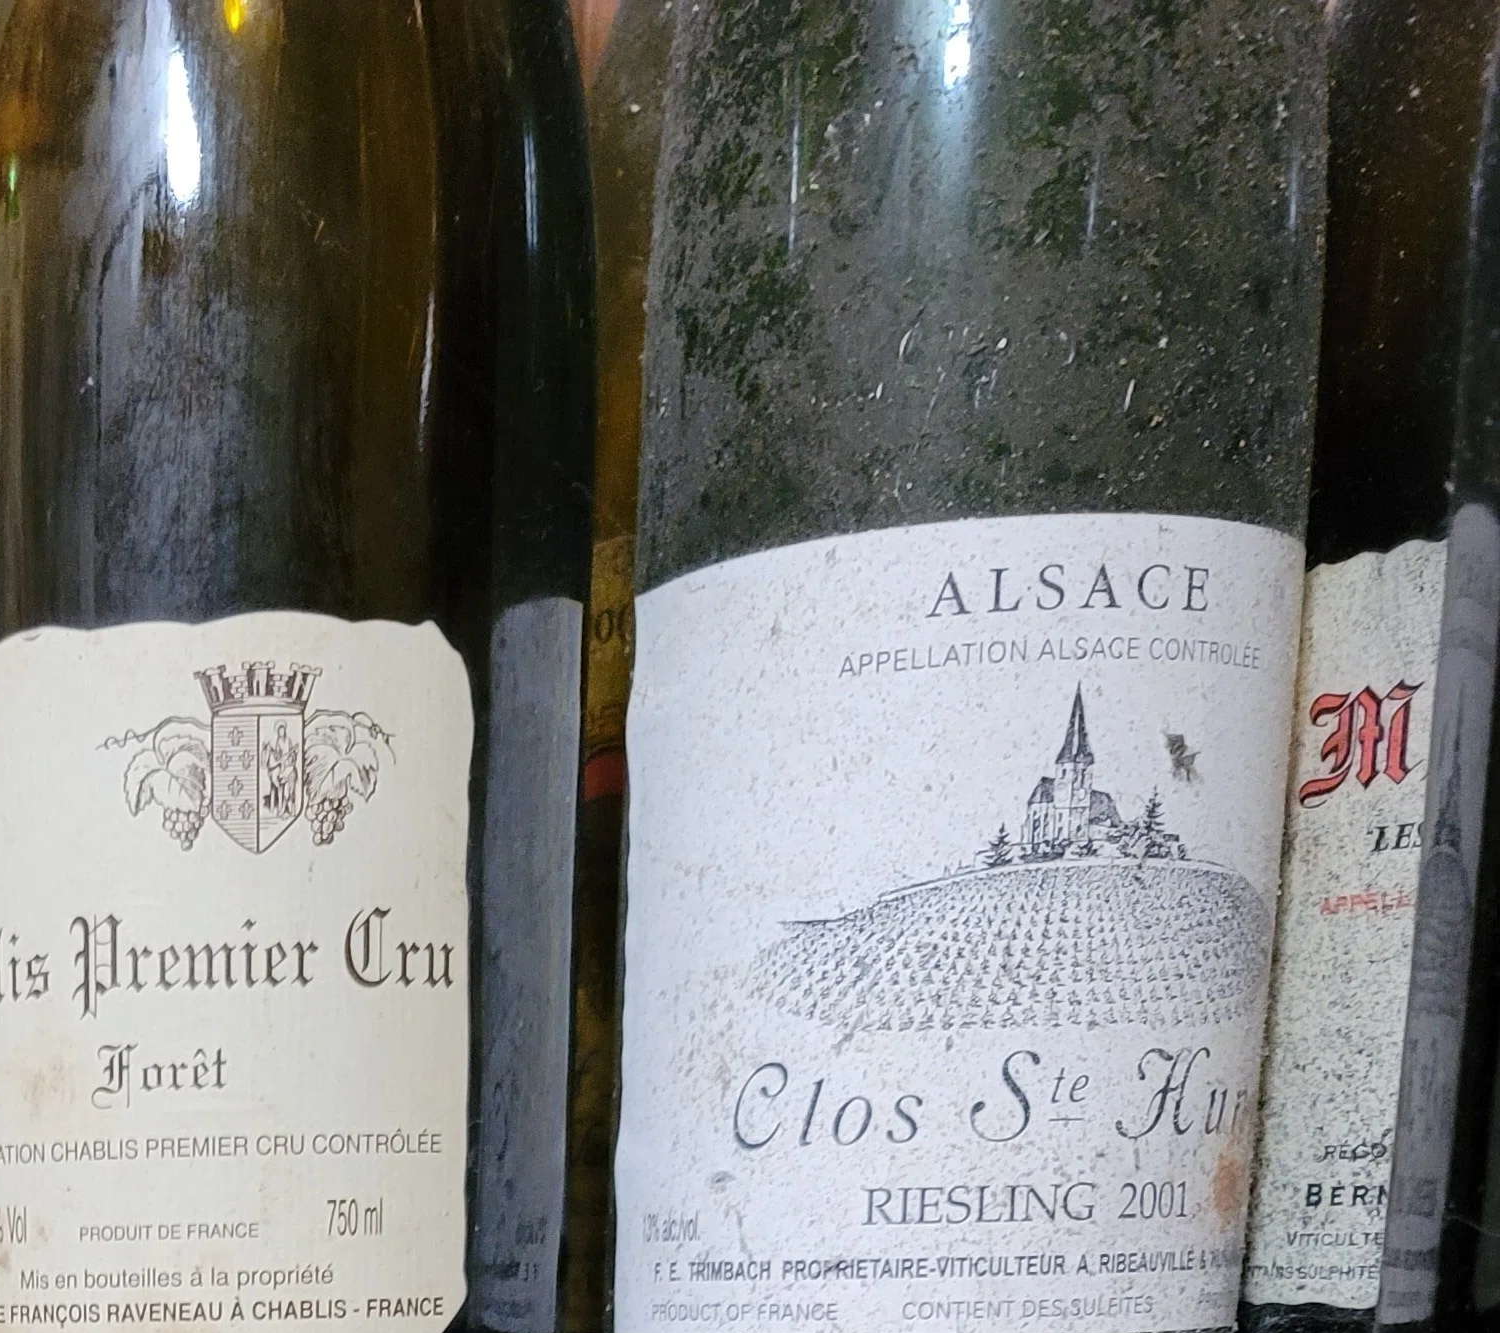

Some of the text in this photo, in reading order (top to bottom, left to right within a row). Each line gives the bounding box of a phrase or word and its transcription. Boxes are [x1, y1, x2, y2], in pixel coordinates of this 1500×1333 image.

[924, 562, 1211, 618] ALSACE
[837, 638, 1028, 679] APPELLATION
[1036, 636, 1141, 661] ALSACE
[1319, 887, 1415, 917] APPELL
[69, 911, 320, 1021] Premier
[344, 906, 457, 990] Cru
[91, 1042, 228, 1109] Forêt
[732, 1061, 924, 1150] Clos
[50, 1139, 139, 1162] CHABLIS
[145, 1134, 250, 1159] PREMIER
[255, 1133, 304, 1157] CRU
[311, 1127, 443, 1156] CONTRÔLÉE
[860, 1180, 1189, 1226] RIESLING 2001
[1305, 1183, 1389, 1207] BERN
[7, 1206, 28, 1244] Vol
[79, 1222, 260, 1242] PRODUIT DE FRANCE
[326, 1197, 383, 1237] 750 ml
[1286, 1230, 1385, 1247] VITICULTE
[20, 1262, 334, 1290] Mis en bouteilles à la propriété
[687, 1259, 772, 1282] TRIMBACH
[10, 1303, 100, 1329] FRANÇOIS
[106, 1301, 223, 1323] RAVENEAU
[252, 1299, 347, 1321] CHABLIS
[366, 1296, 445, 1318] FRANCE
[651, 1296, 1153, 1322] PRODUCT OF FRANCE CONTIENT DES SULFITES
